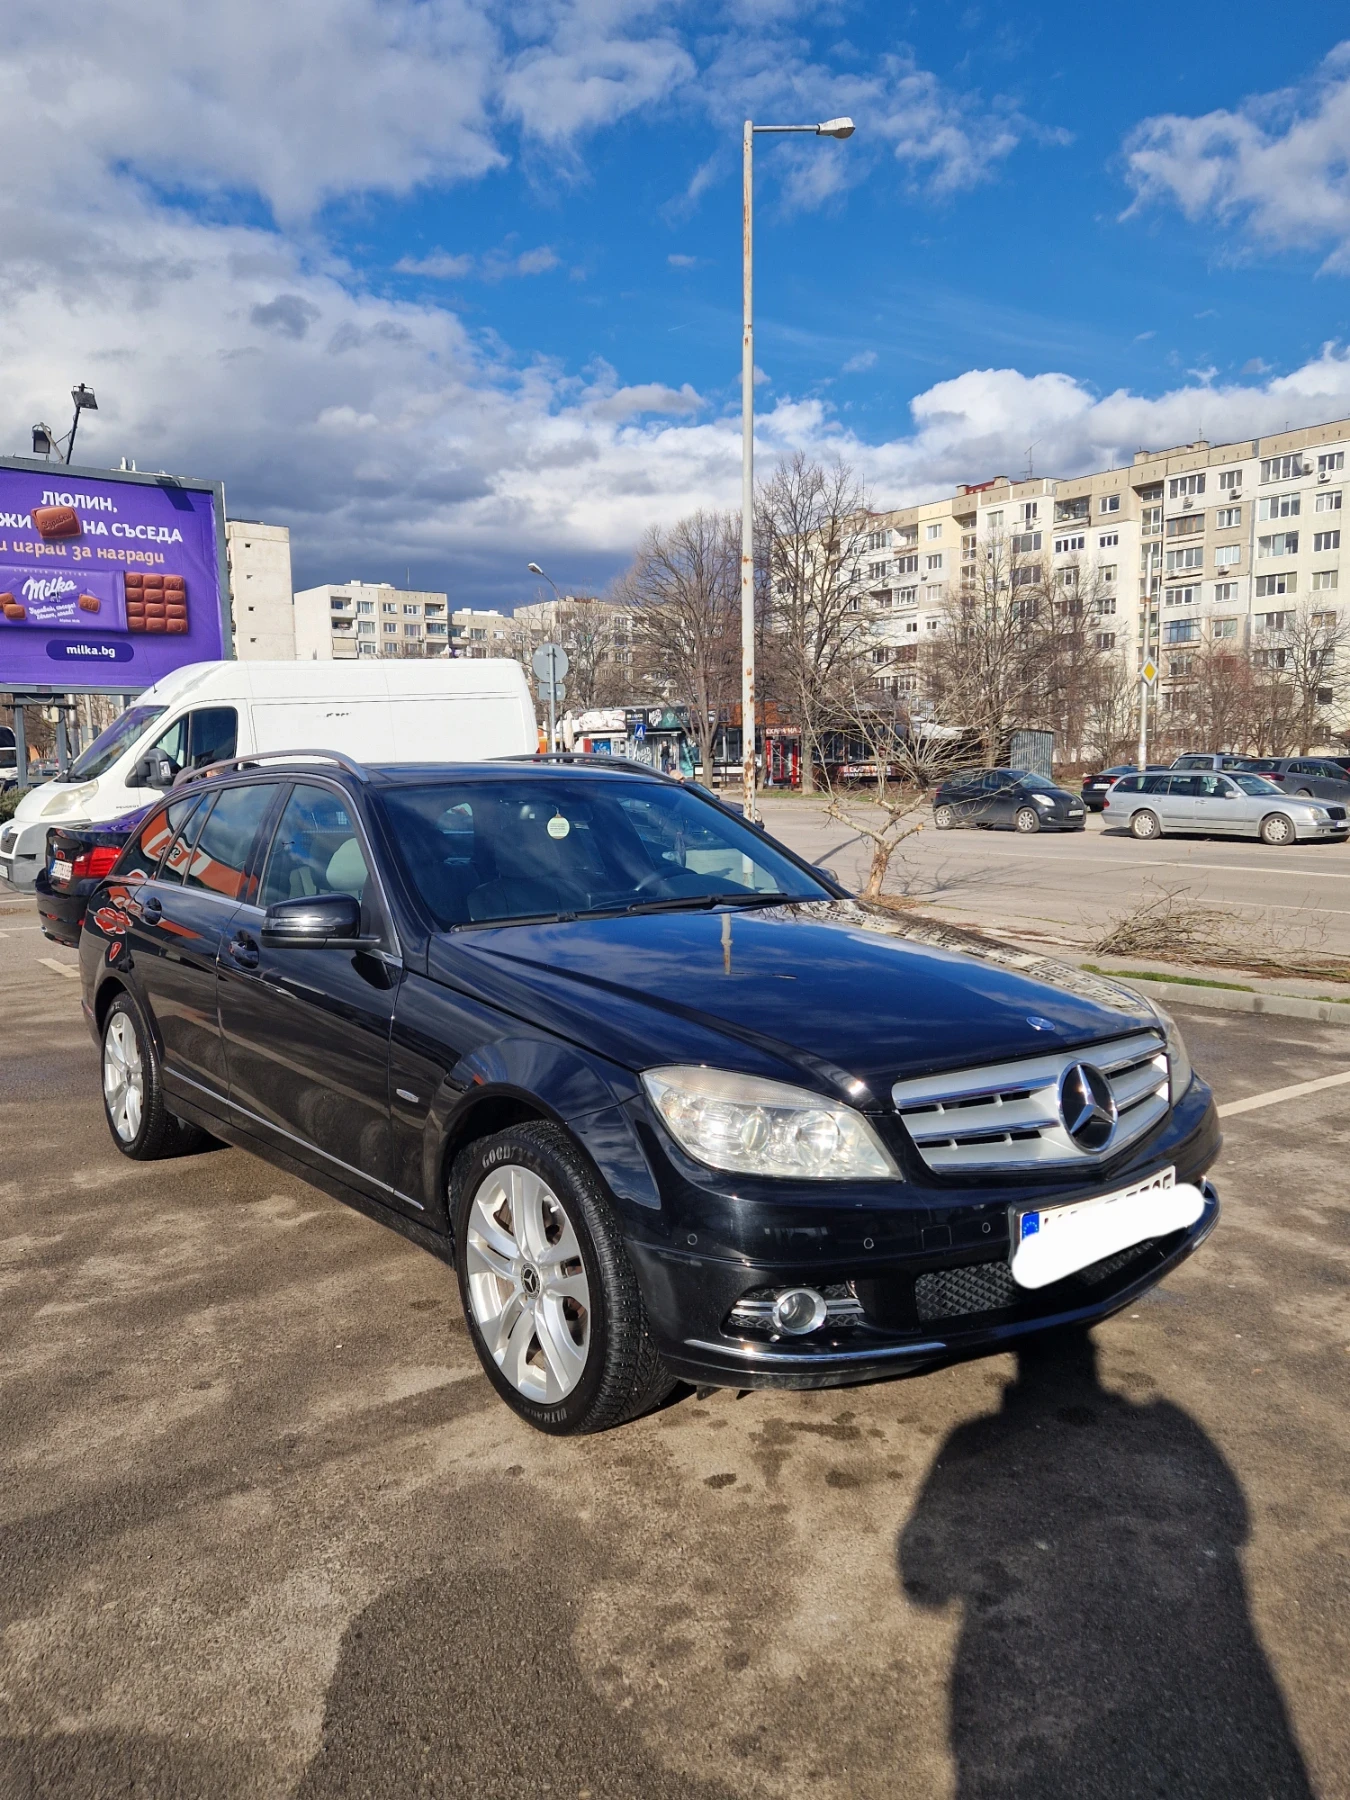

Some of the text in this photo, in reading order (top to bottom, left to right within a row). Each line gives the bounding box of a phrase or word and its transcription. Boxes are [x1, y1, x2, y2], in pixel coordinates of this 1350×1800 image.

[41, 490, 118, 513] ЛЮЛИН,
[82, 520, 109, 536] НА
[111, 523, 183, 544] СЪСЕДА
[13, 541, 67, 557] играй
[71, 545, 92, 561] за
[97, 547, 165, 566] награди
[21, 576, 77, 601] Milka
[66, 644, 115, 658] milka.bg
